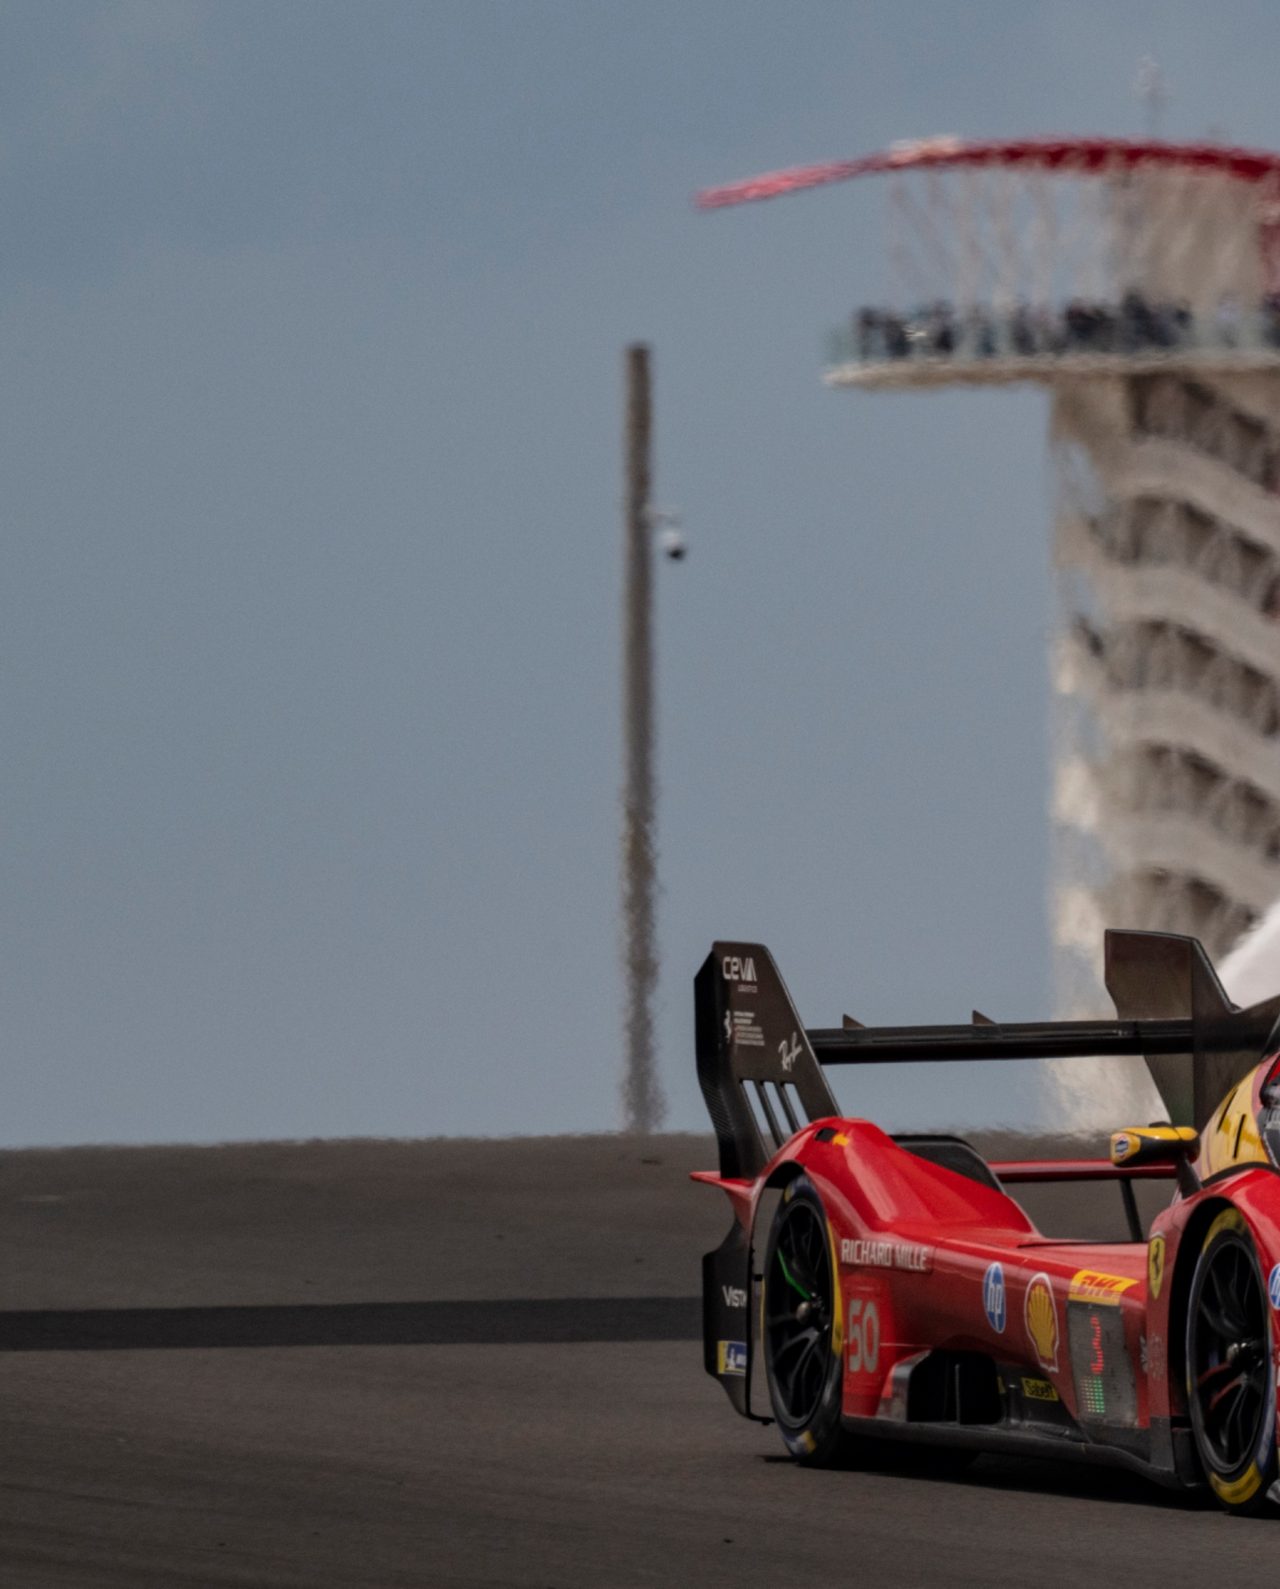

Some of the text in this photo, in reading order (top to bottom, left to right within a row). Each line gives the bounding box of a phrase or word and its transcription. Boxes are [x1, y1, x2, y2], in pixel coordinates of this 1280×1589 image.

[841, 1239, 928, 1271] RICHARD MILLE
[986, 1264, 1003, 1331] hp
[848, 1300, 880, 1373] 50
